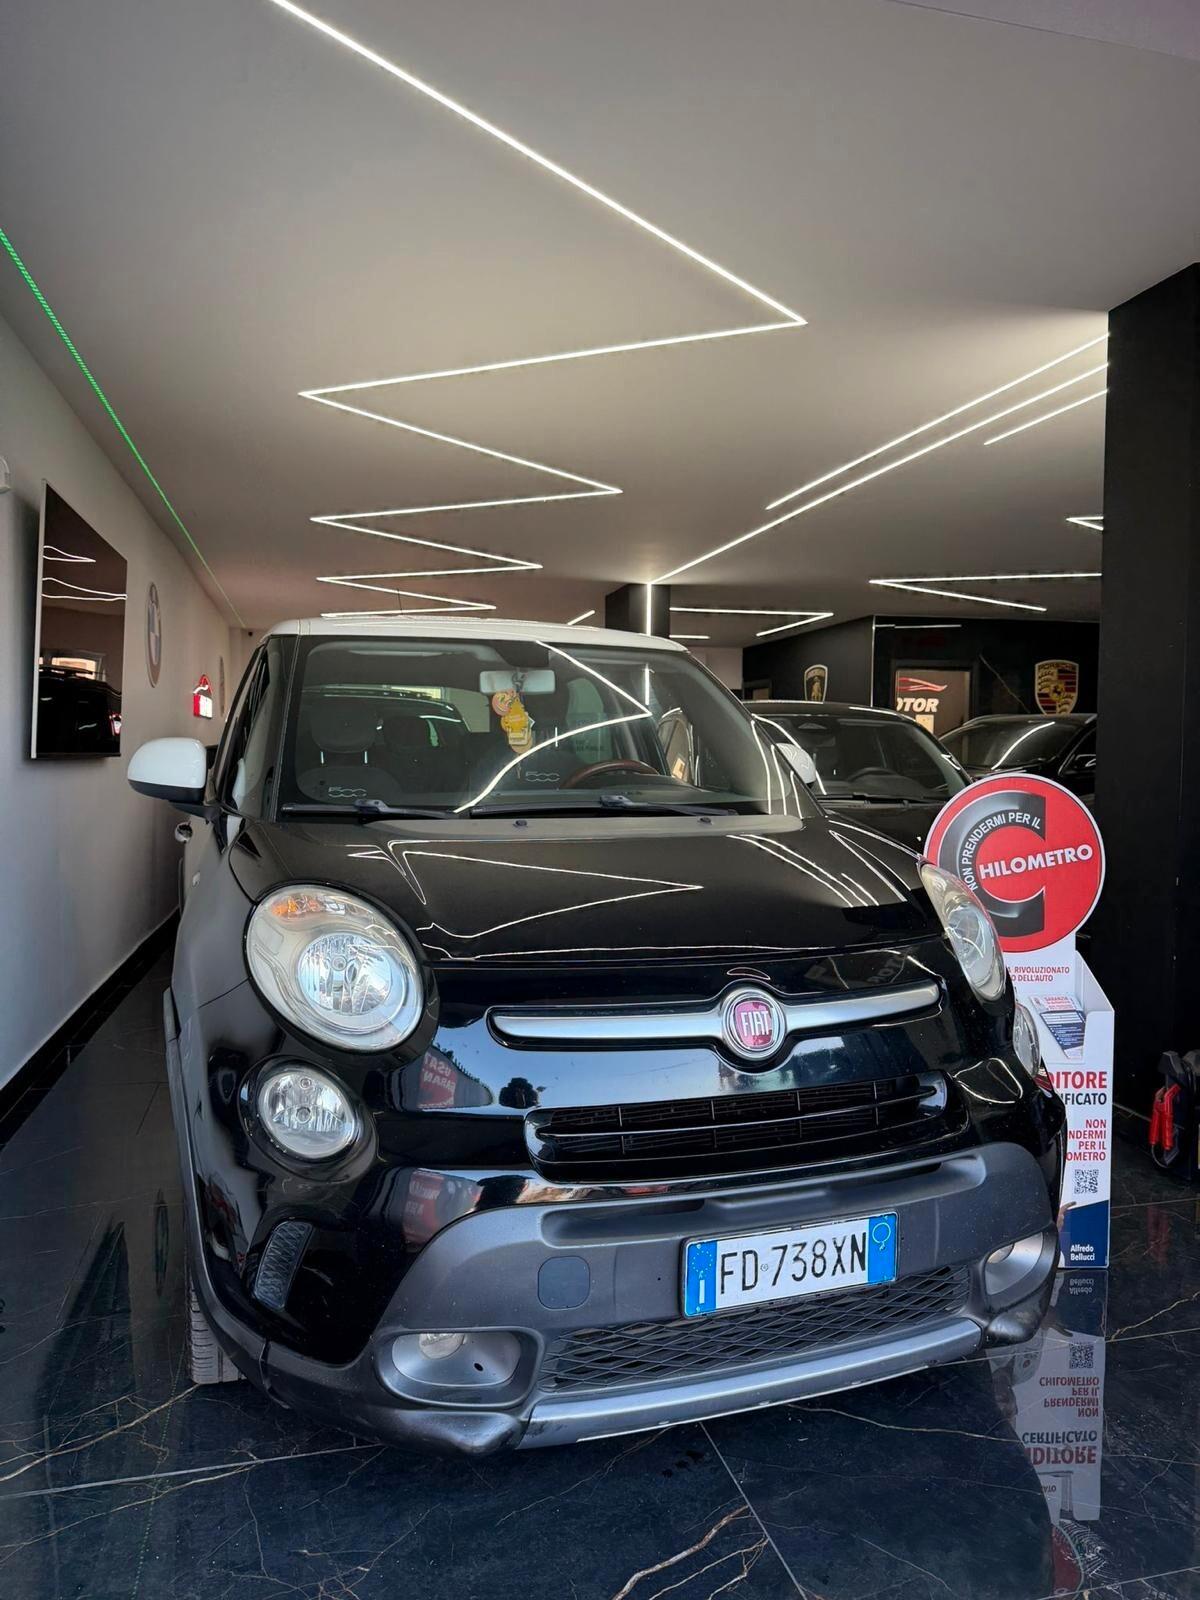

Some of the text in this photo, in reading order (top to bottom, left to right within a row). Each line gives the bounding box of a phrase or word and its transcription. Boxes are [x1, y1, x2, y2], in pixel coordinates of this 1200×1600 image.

[961, 812, 1041, 891] NON PRENDERMI PER IL
[1014, 966, 1070, 974] RIVOLUZIONATO
[1017, 974, 1054, 982] DELL'AUTO
[740, 1010, 770, 1037] FIAT
[1085, 1119, 1107, 1128] NON
[1068, 1130, 1107, 1139] NDERMI
[1078, 1141, 1107, 1150] PER IL
[1070, 1244, 1094, 1252] Alfredo
[771, 1232, 867, 1287] 738XN
[1070, 1253, 1095, 1261] Bellucci
